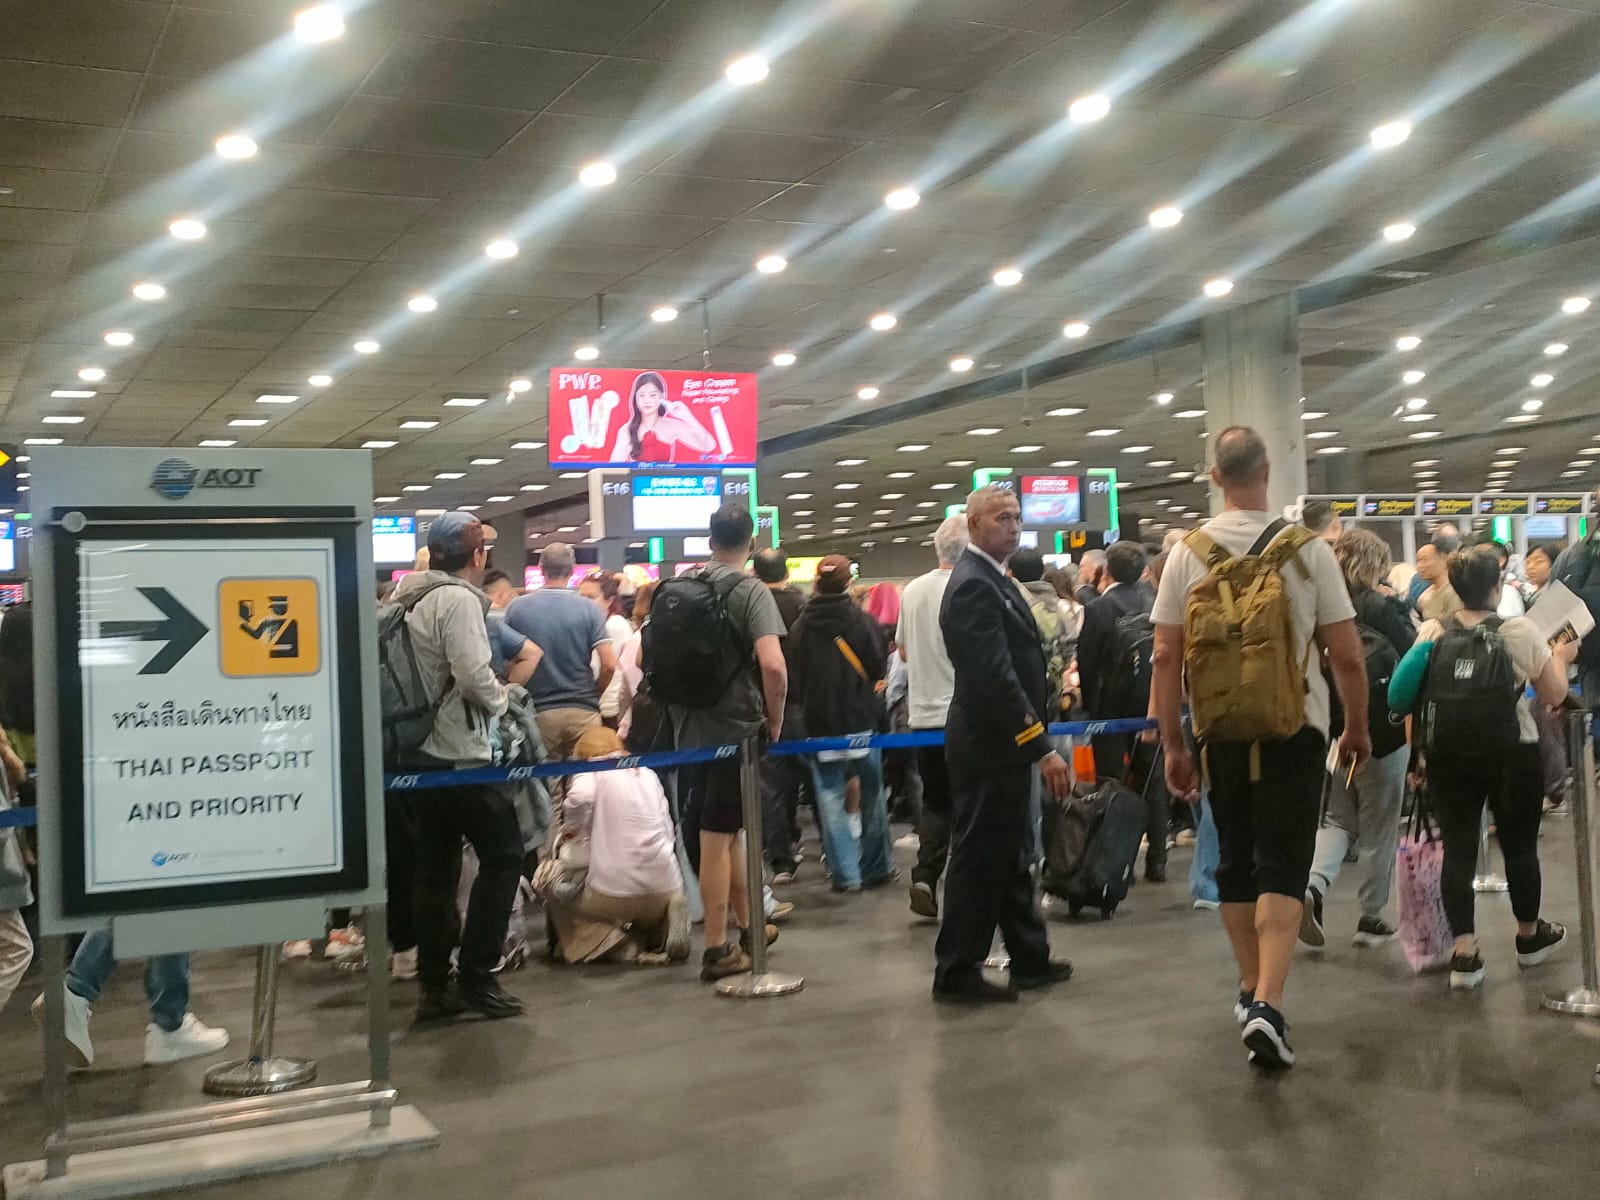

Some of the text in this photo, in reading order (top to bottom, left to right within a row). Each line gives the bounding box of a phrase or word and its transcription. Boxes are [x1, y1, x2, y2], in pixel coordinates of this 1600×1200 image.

[201, 468, 264, 485] AOT
[603, 482, 631, 497] E16
[724, 482, 750, 496] E15
[112, 692, 312, 729] หนังสือเดินทางไทย
[114, 750, 314, 778] THAI PASSPORT
[389, 774, 420, 789] AOT
[127, 792, 304, 822] AND PRIORITY
